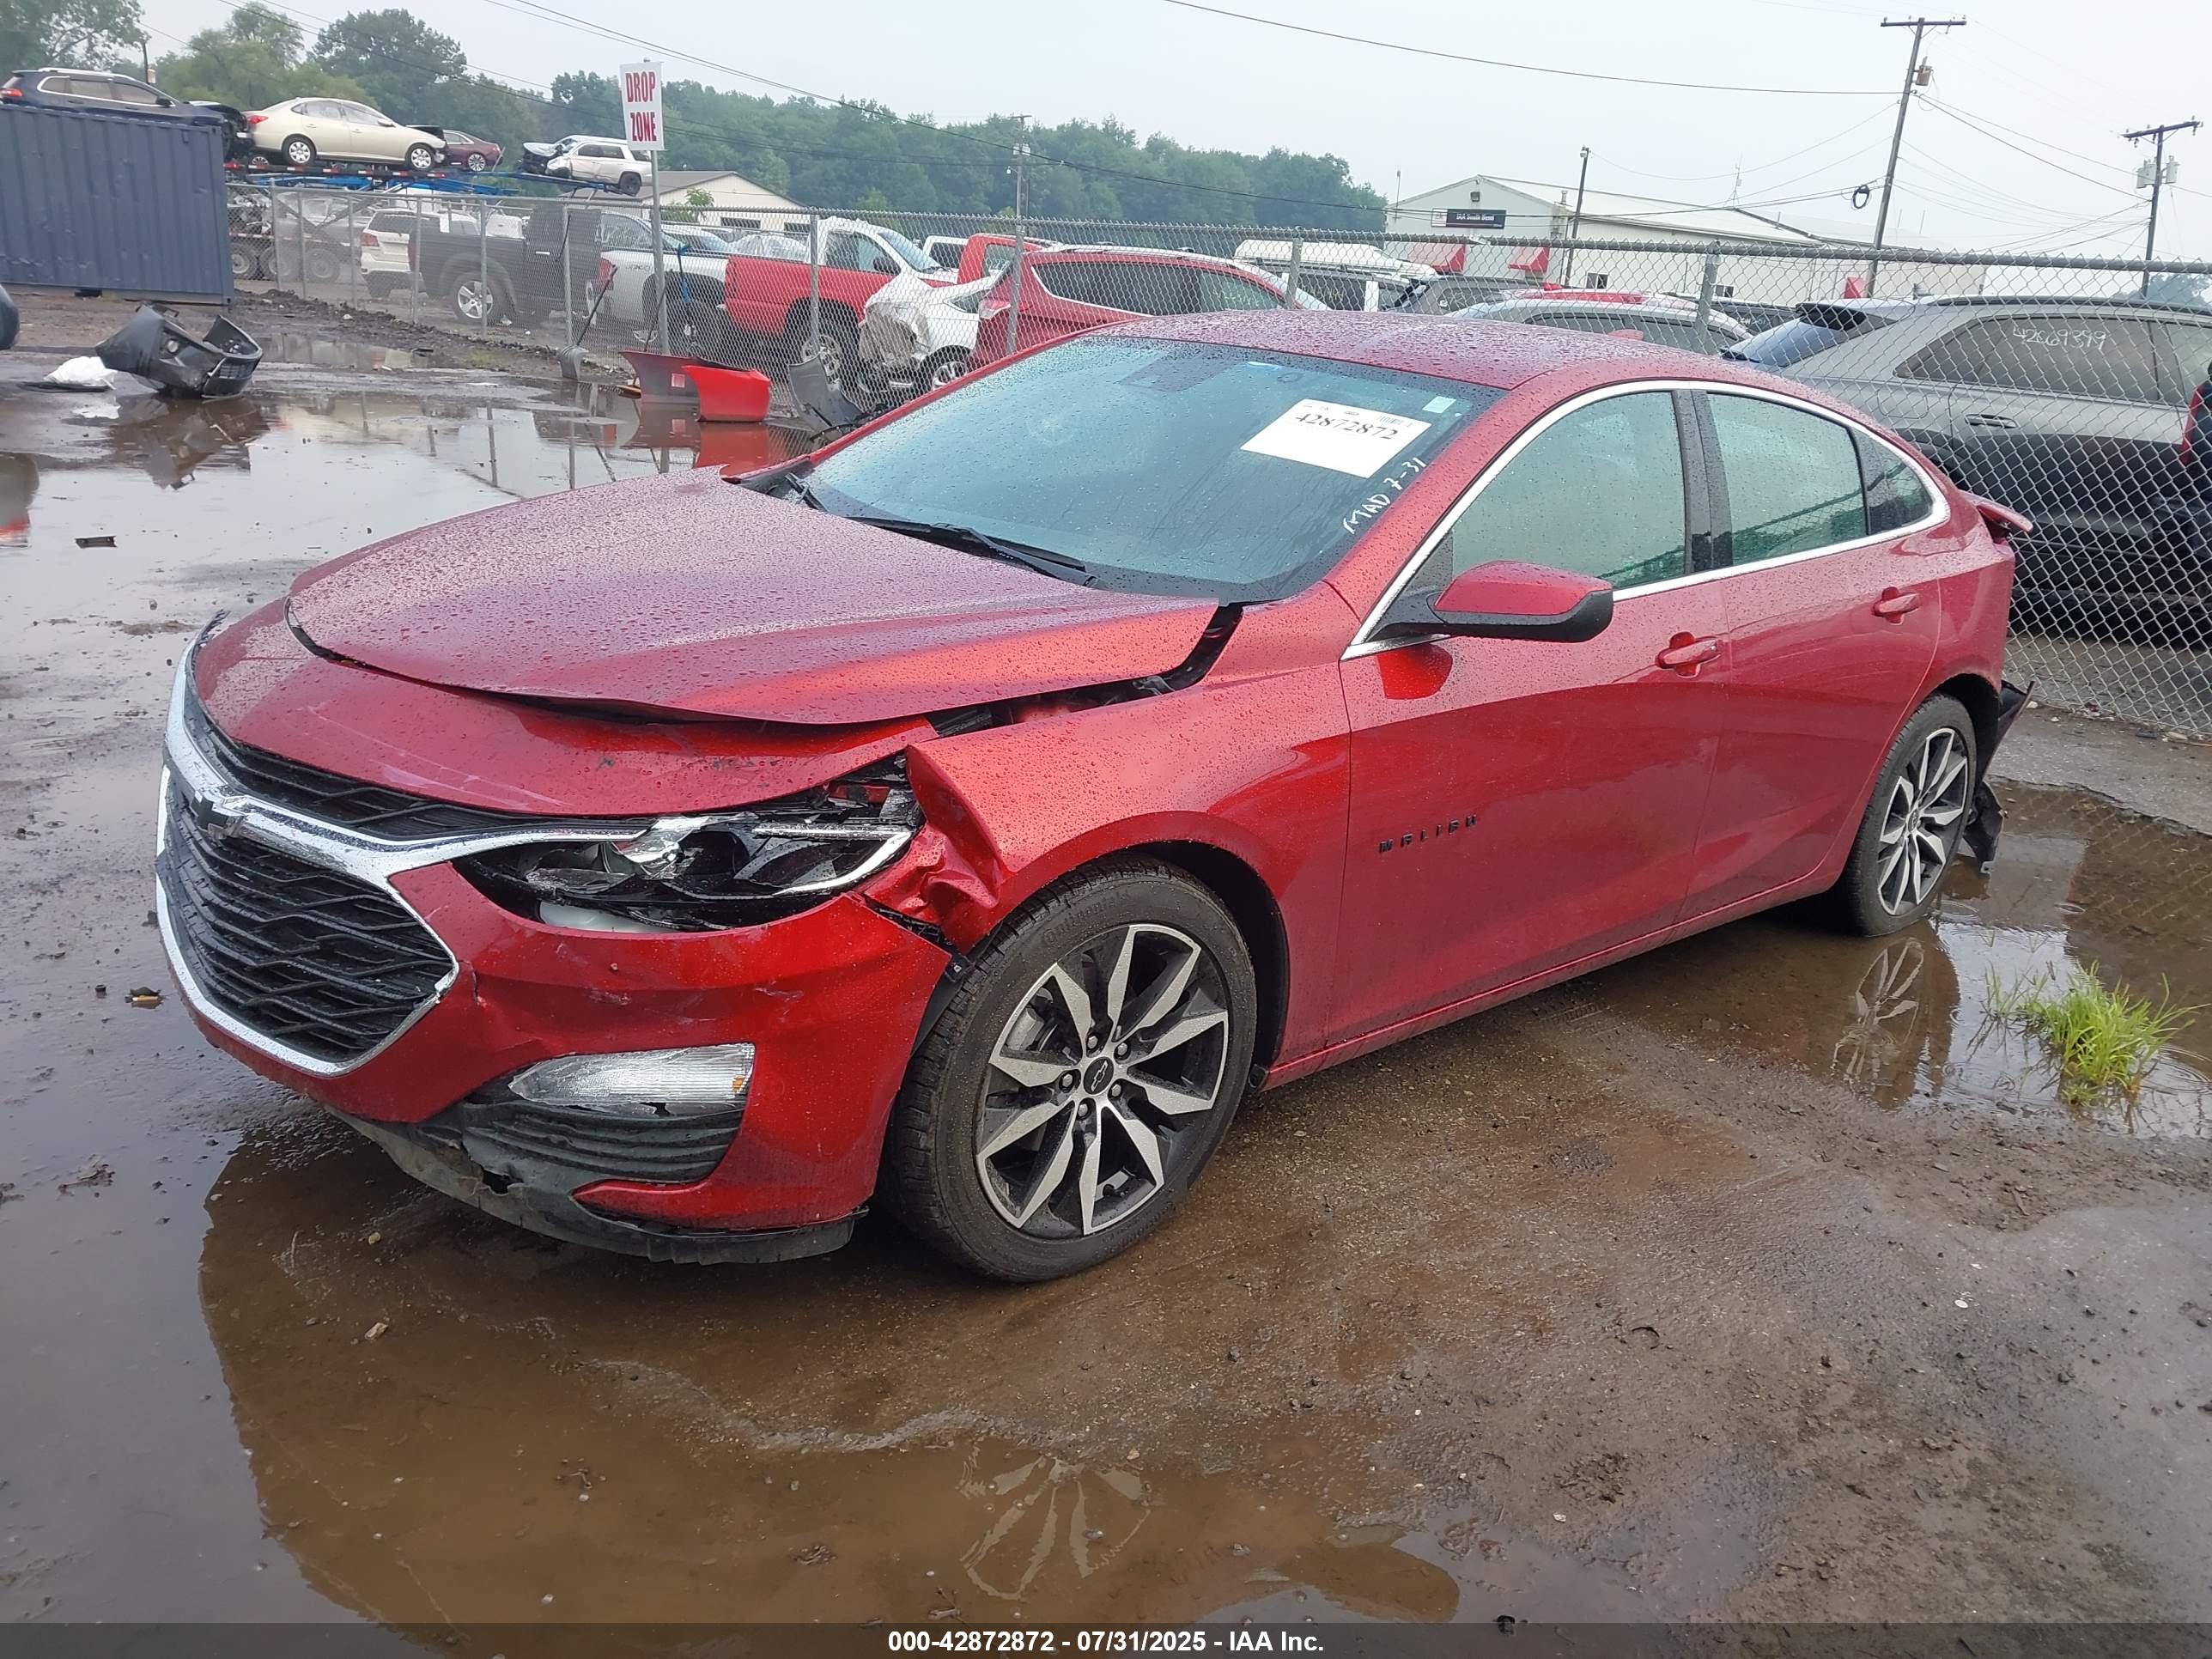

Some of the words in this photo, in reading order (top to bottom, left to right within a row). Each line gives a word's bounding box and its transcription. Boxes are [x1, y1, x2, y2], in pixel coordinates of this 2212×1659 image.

[625, 71, 656, 102] DROP
[630, 112, 657, 142] ZONE
[1296, 413, 1398, 440] 42872872
[1382, 457, 1426, 490] 7-31
